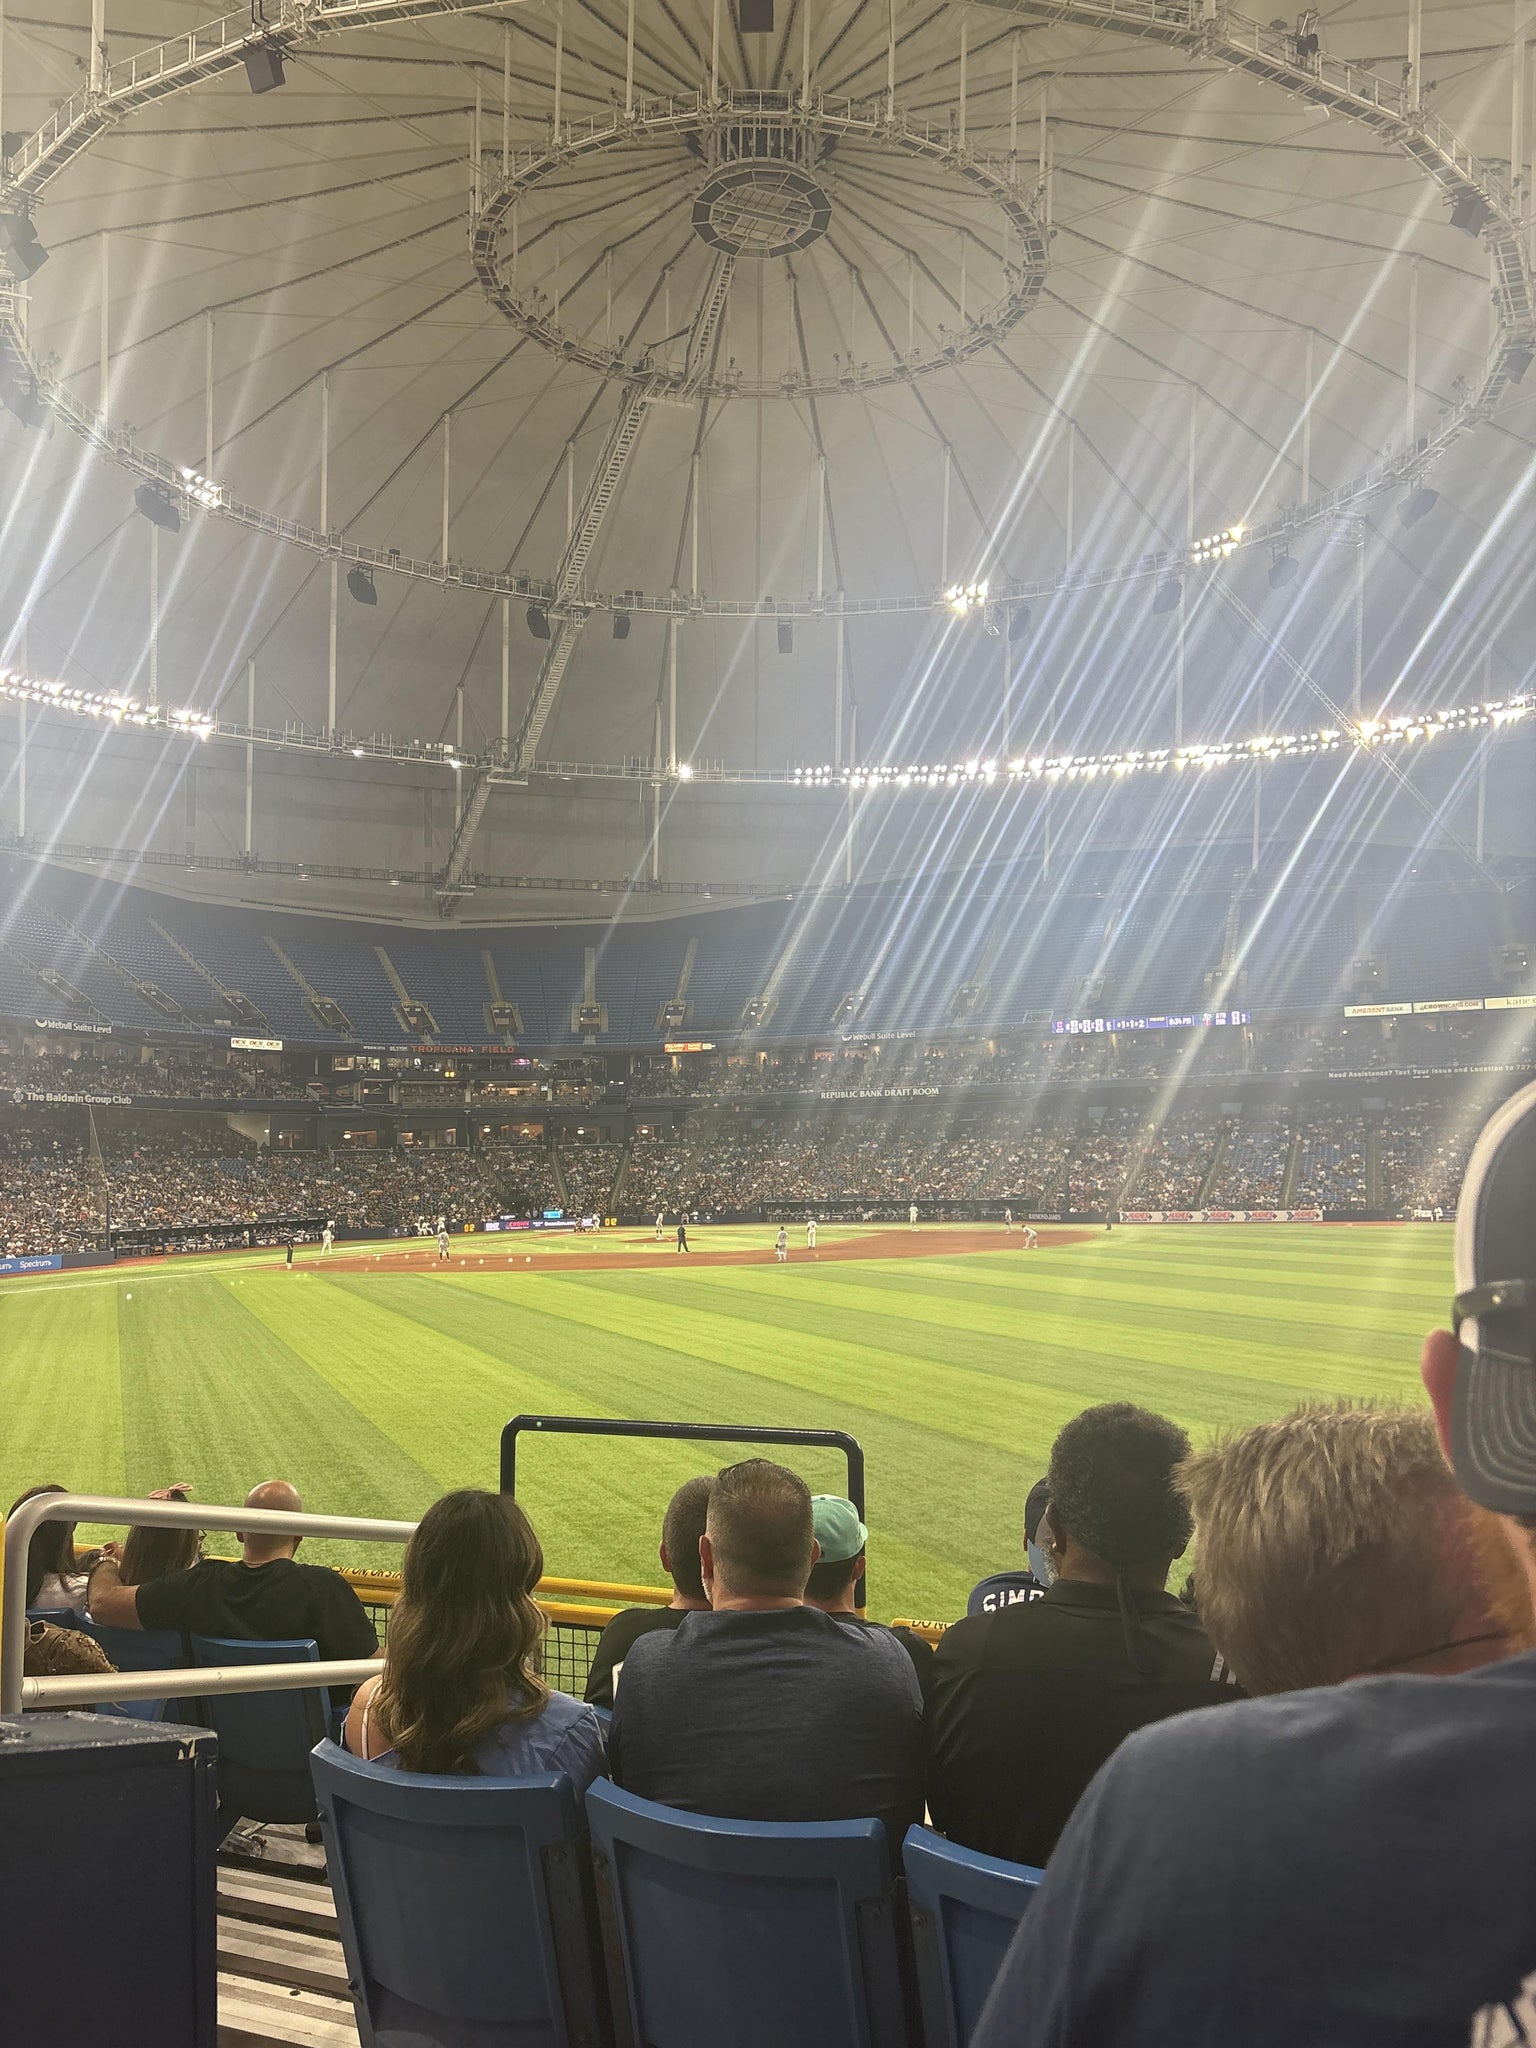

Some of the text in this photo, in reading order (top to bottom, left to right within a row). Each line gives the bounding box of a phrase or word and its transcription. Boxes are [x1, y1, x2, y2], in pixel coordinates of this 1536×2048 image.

[48, 1020, 111, 1034] Webull Suite Level
[853, 1032, 875, 1040] Webull
[411, 1045, 473, 1053] TROPICANA
[26, 1091, 132, 1105] The Baldwin Group Club
[820, 1091, 858, 1099] REPUBLIC
[860, 1089, 882, 1098] BANK
[884, 1088, 911, 1097] DRAFT
[912, 1087, 940, 1096] ROOM
[20, 1260, 50, 1270] Spectrum
